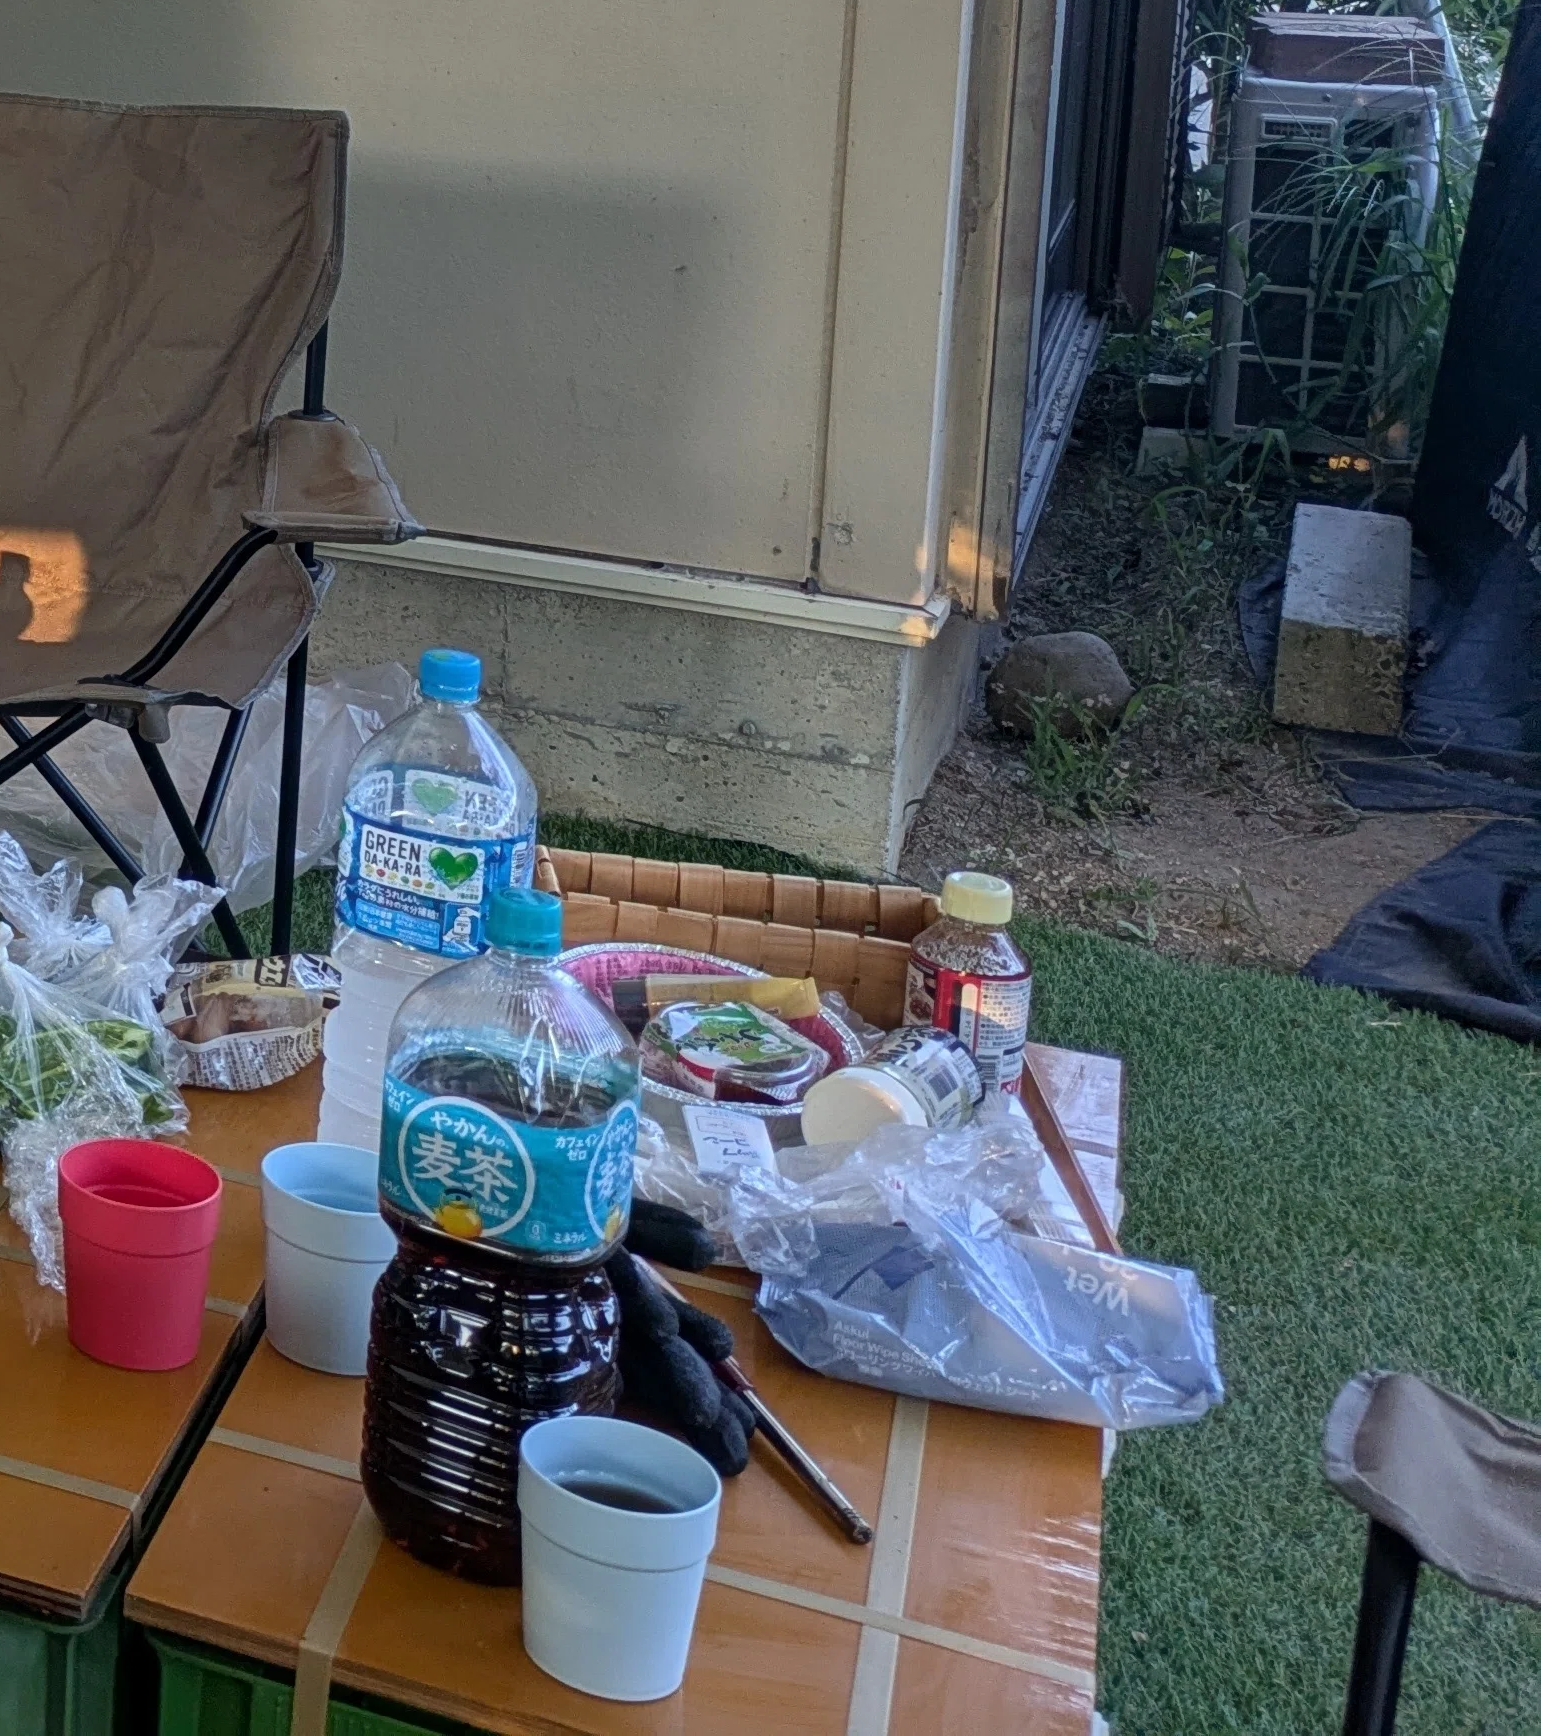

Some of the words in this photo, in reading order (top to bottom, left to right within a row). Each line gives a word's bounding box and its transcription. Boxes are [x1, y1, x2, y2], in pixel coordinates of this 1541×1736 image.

[365, 830, 421, 862] GREEN
[555, 1134, 601, 1150] カフェイン
[412, 1131, 518, 1203] 麦茶
[567, 1150, 587, 1162] ゼロ
[553, 1229, 587, 1244] ミネラル
[1064, 1265, 1129, 1316] Wet
[833, 1320, 867, 1338] Askul
[833, 1332, 867, 1350] Floor
[867, 1342, 899, 1360] Wipe
